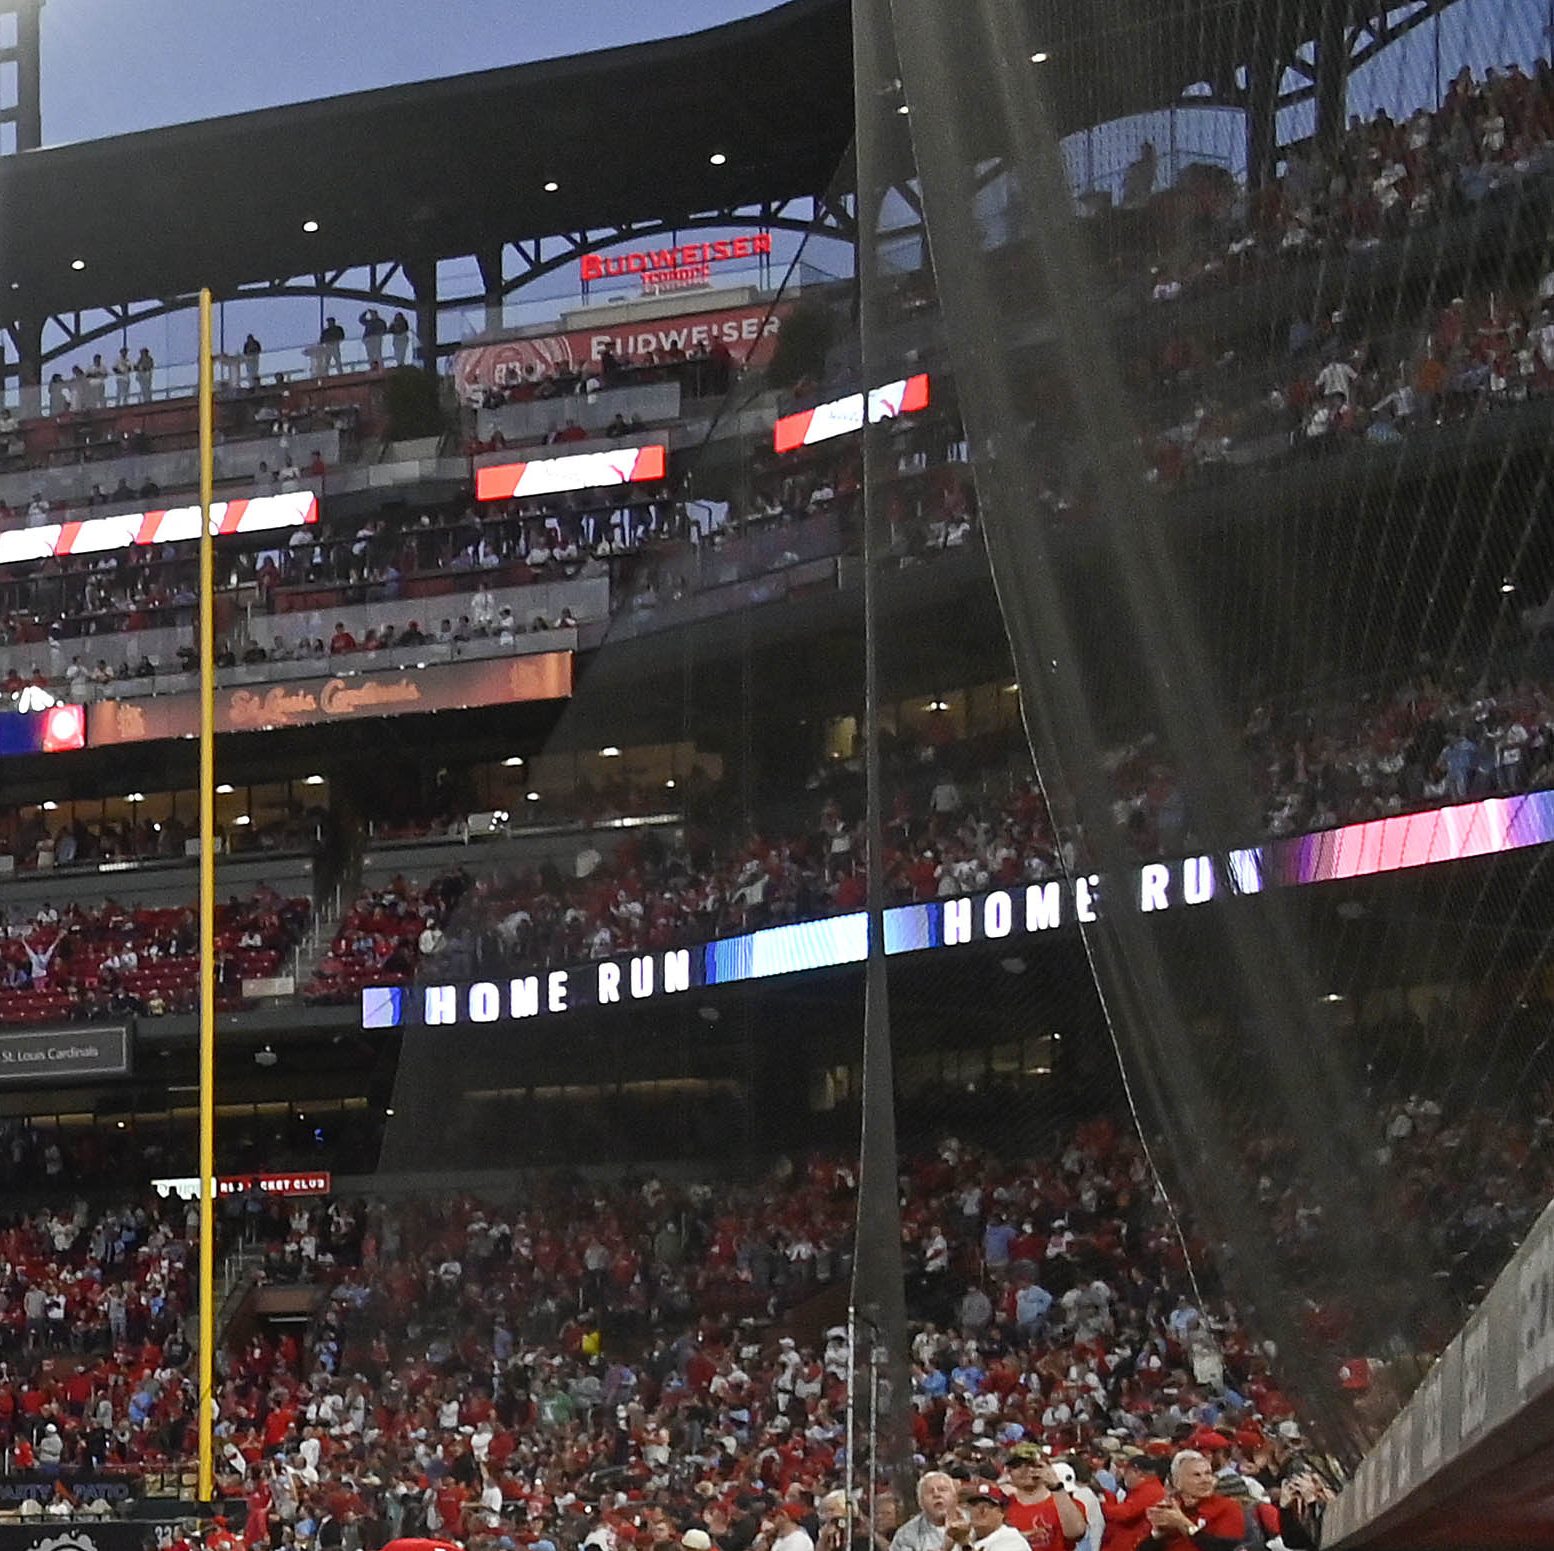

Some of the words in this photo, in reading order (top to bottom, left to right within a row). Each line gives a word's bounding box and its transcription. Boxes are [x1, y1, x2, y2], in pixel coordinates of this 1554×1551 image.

[581, 234, 772, 280] BUDWEISER
[943, 874, 1100, 946] HOME
[424, 970, 569, 1026] HOME
[597, 948, 691, 1004] RUN
[17, 1050, 46, 1063] Louis
[47, 1046, 99, 1061] Cardinals
